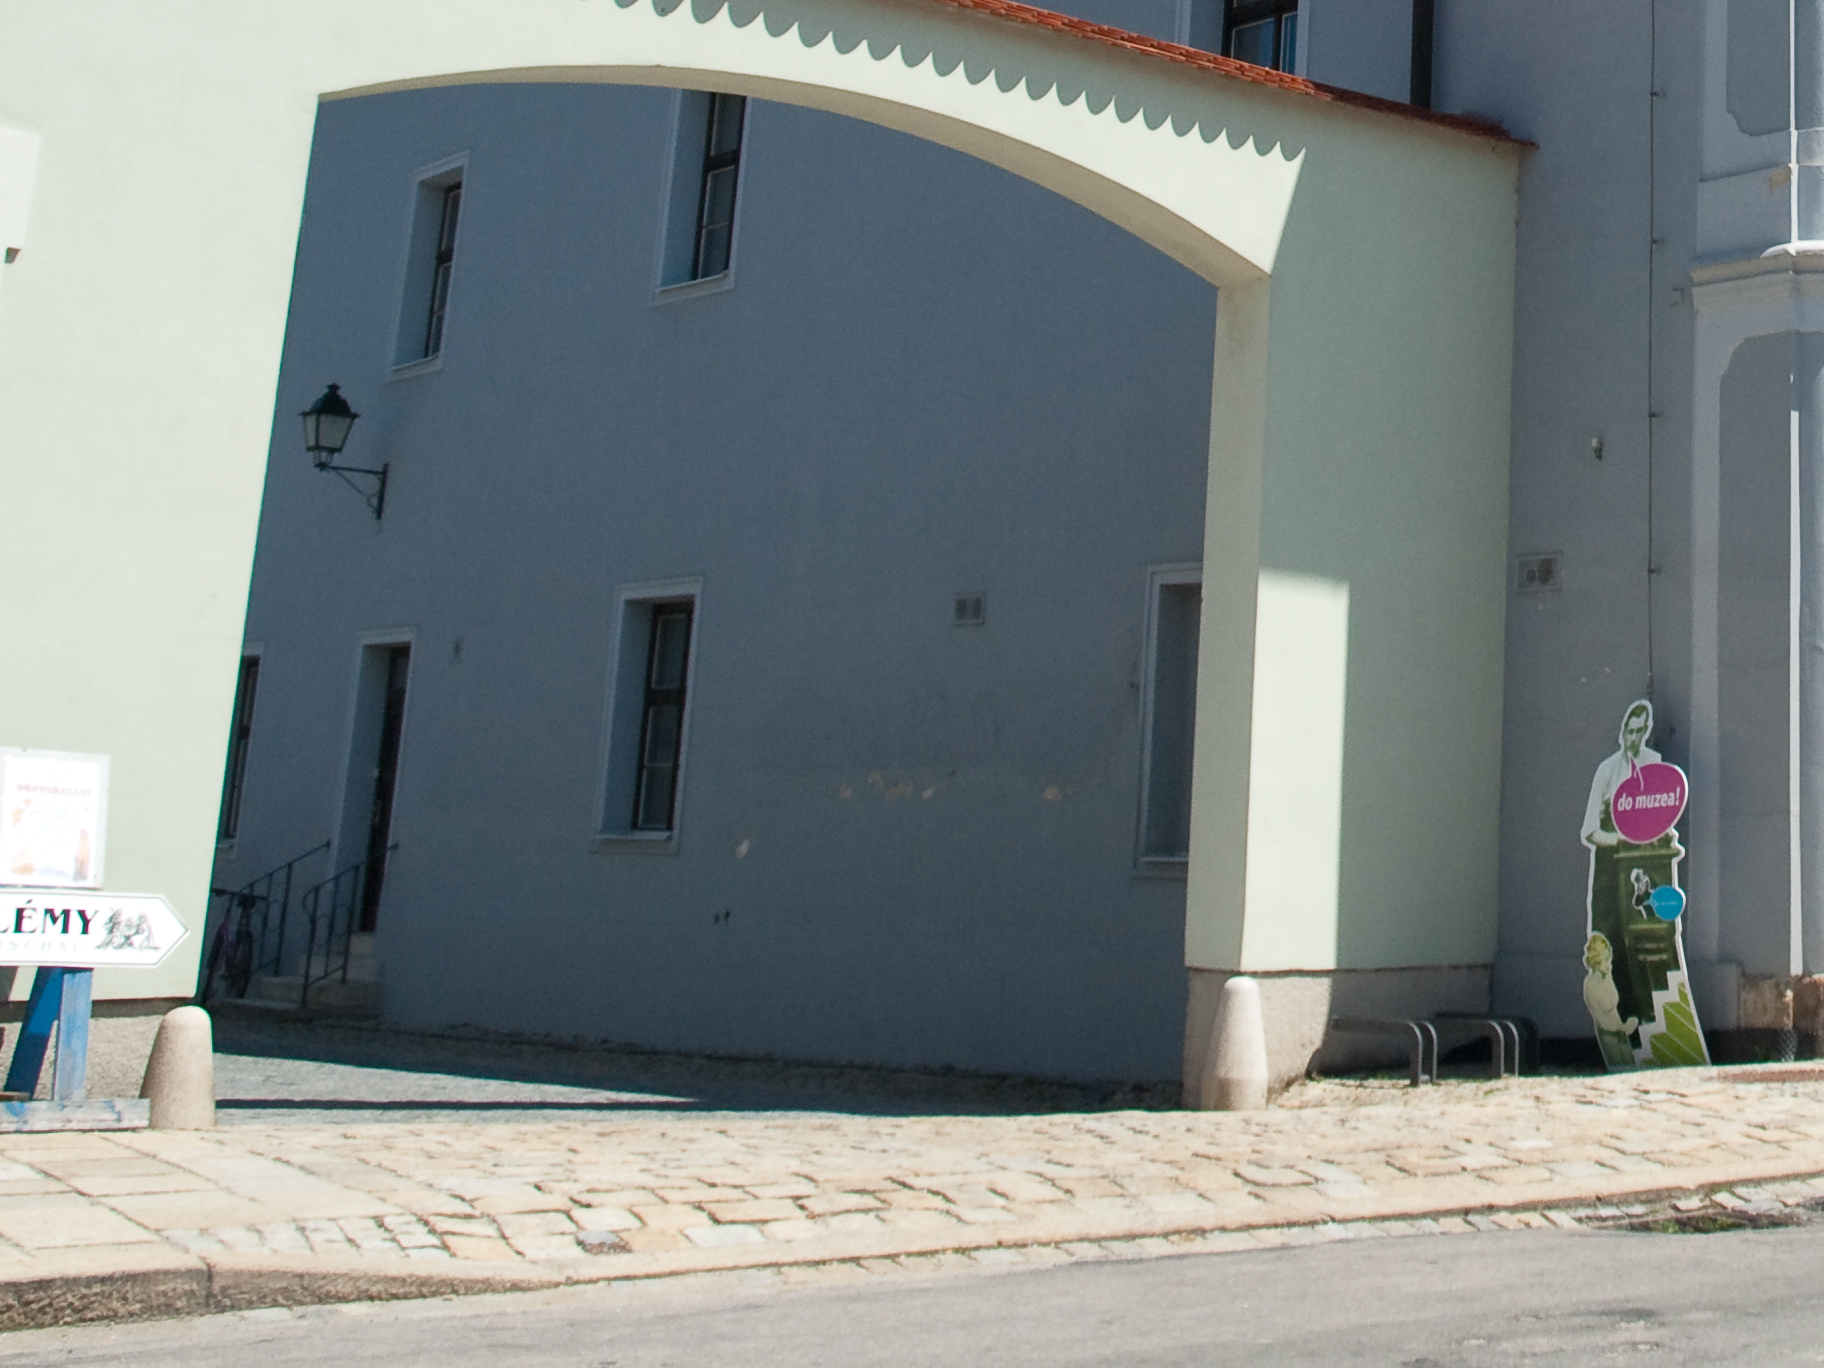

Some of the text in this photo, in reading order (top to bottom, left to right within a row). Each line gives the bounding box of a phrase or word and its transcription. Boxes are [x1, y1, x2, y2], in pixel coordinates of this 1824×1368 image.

[1617, 786, 1681, 812] do muzea!
[0, 940, 84, 952] SCHAU
